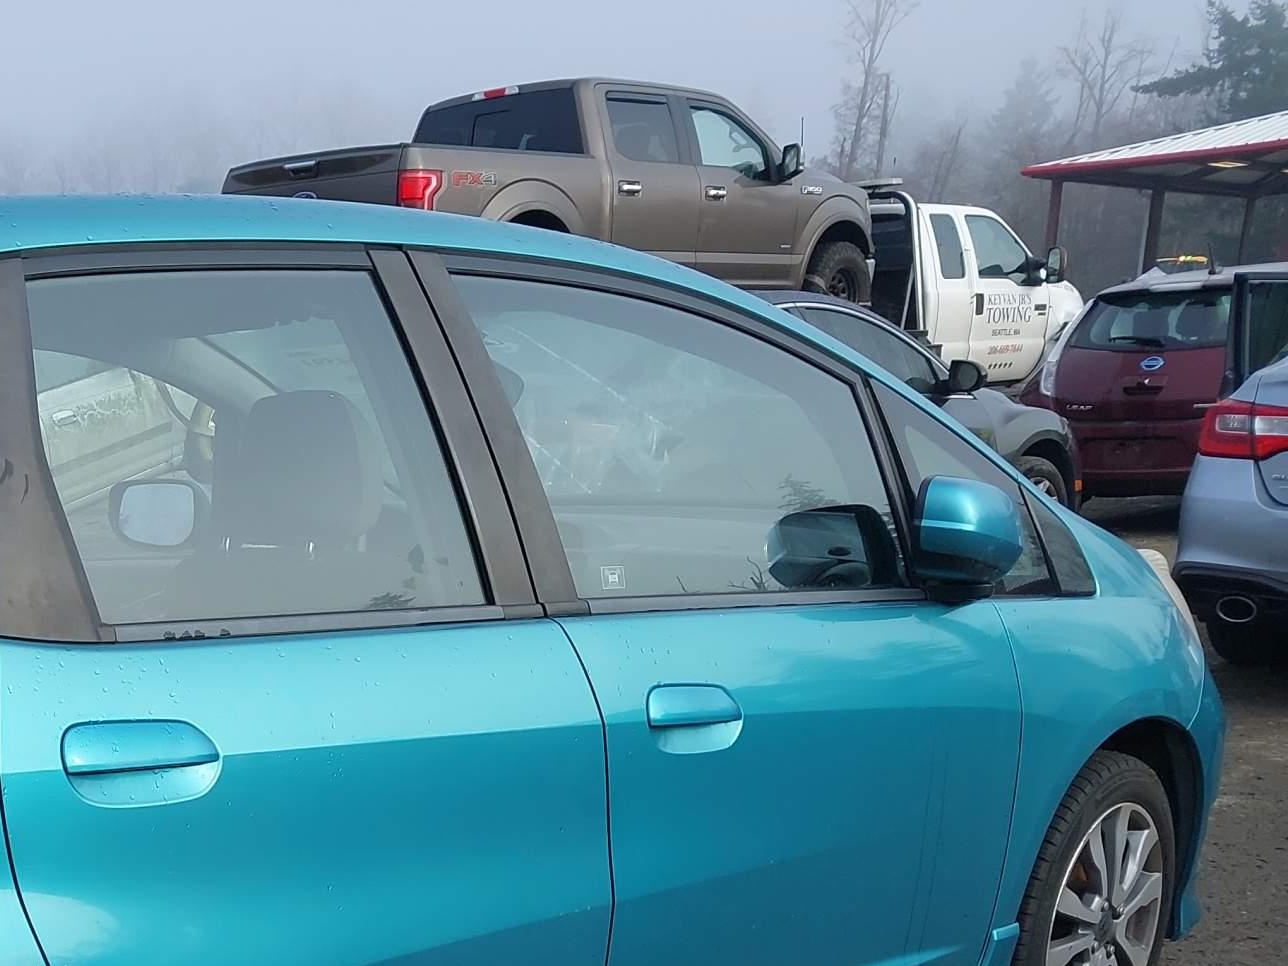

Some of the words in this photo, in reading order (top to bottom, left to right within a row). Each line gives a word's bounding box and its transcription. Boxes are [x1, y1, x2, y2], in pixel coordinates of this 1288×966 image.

[452, 171, 497, 187] FX4
[987, 293, 1017, 306] KEYVAN
[986, 306, 1032, 324] TOWING
